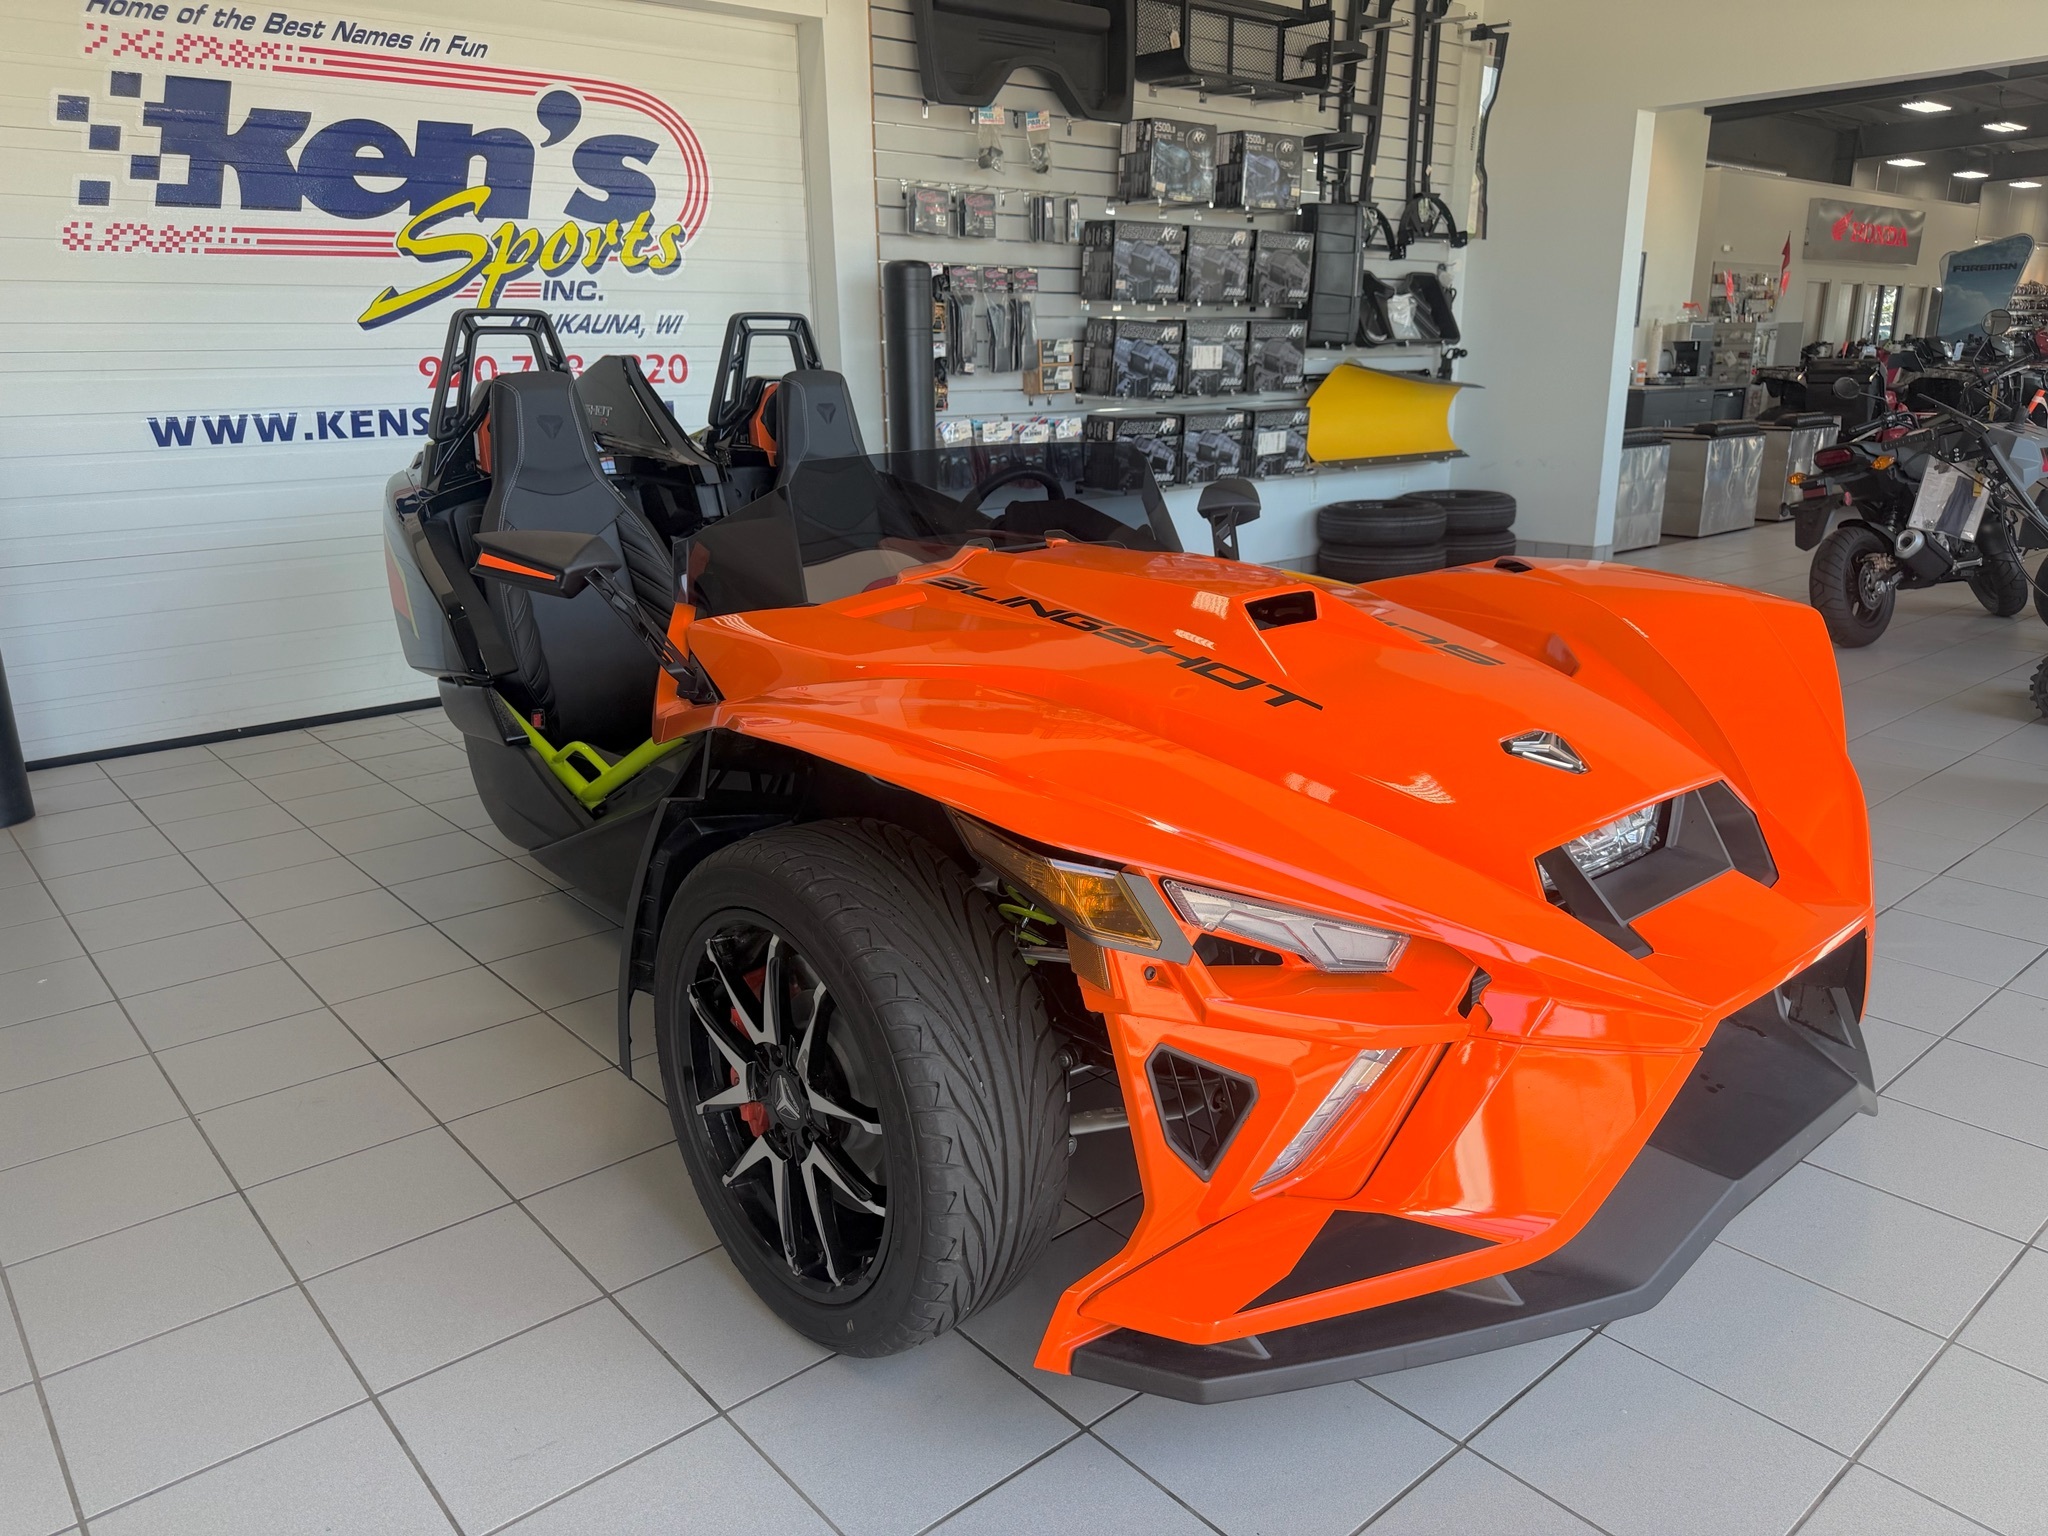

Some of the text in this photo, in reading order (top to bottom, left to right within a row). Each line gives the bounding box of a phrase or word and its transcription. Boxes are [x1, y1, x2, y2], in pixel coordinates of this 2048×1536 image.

[86, 0, 489, 59] Home of the Best Names in Fun
[1851, 221, 1909, 247] HONDA
[357, 186, 685, 329] Sports
[1952, 262, 2018, 273] FOREMAN
[542, 280, 604, 301] INC.
[511, 314, 684, 338] KKAUNA, WI
[923, 576, 1323, 711] SLINGSHOT
